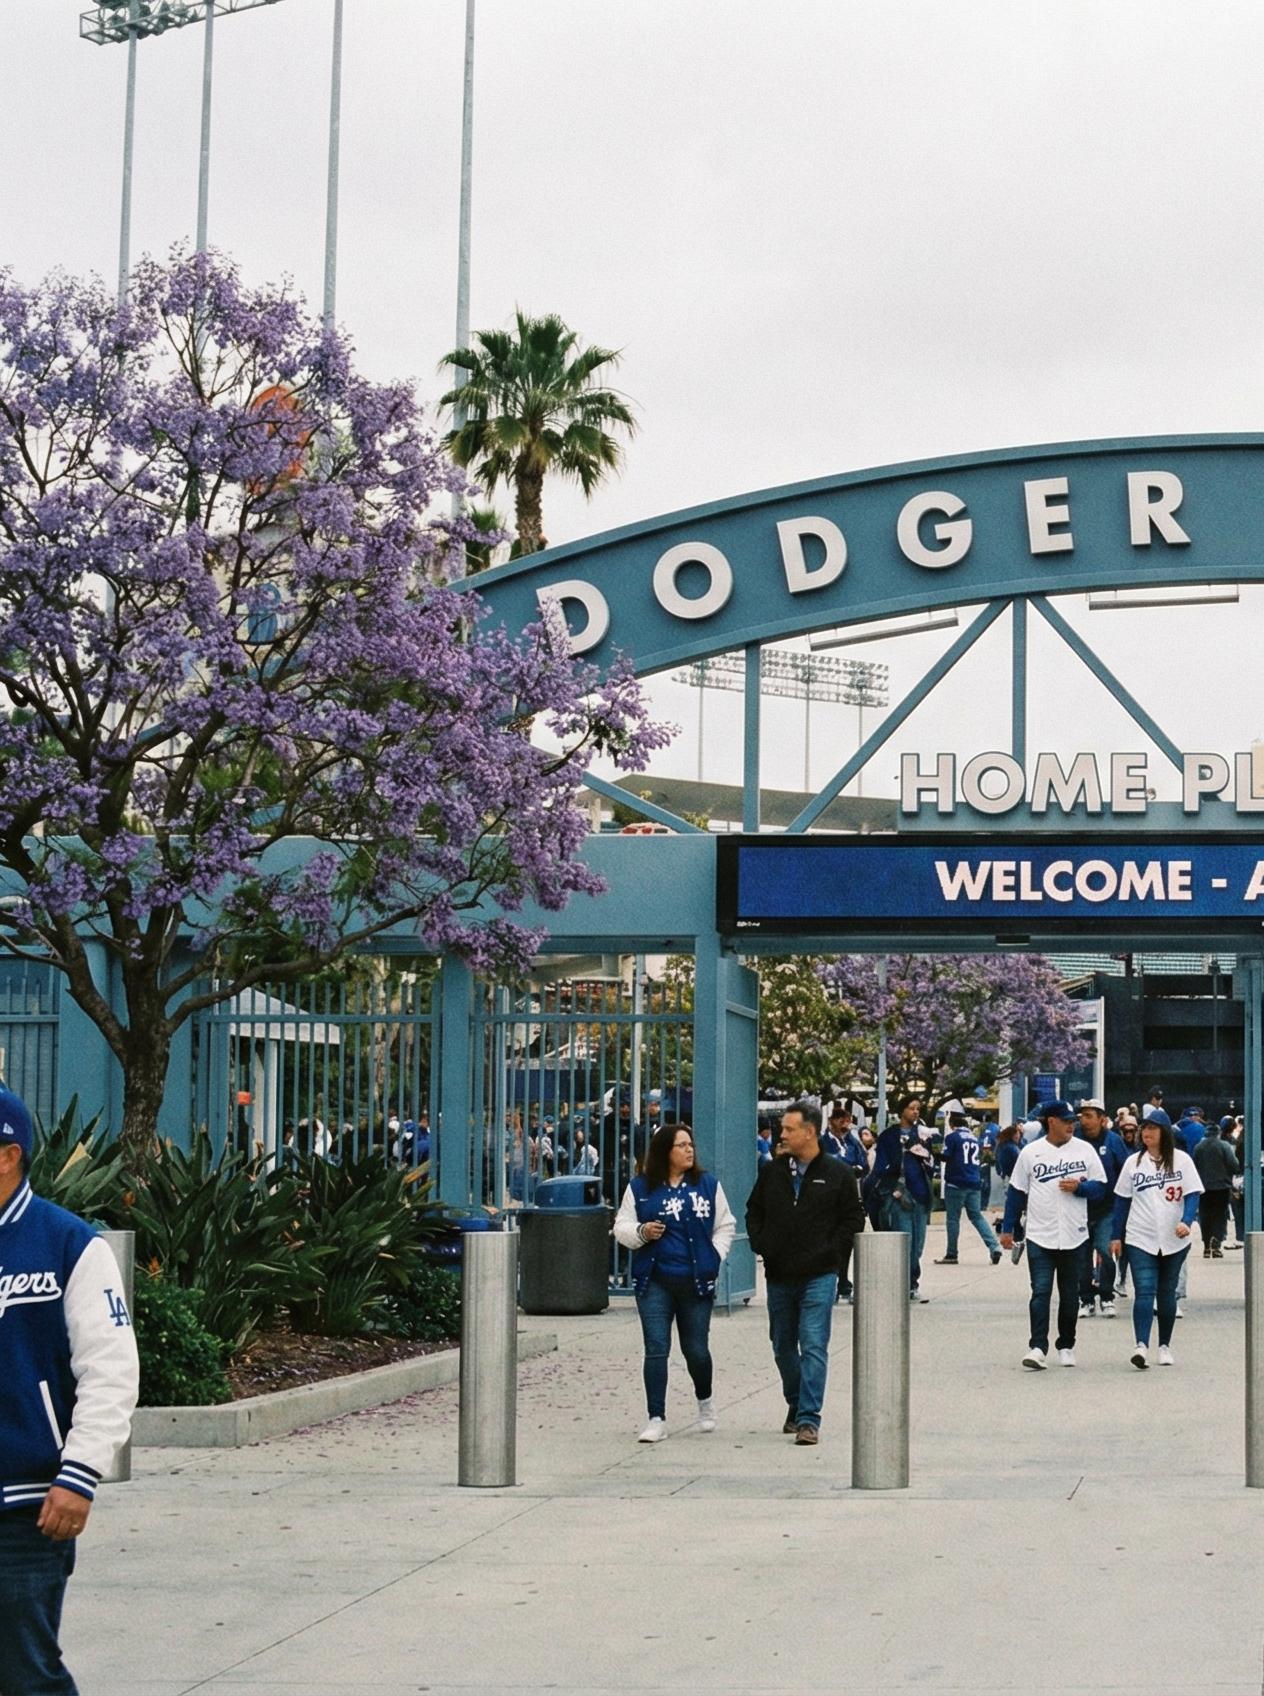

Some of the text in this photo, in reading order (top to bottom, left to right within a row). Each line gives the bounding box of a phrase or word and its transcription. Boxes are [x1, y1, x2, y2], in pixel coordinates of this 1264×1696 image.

[536, 470, 1191, 655] DODGER
[900, 751, 1149, 816] HOME
[935, 859, 1192, 903] WELCOME
[0, 1267, 62, 1318] gers
[103, 1288, 131, 1327] LA
